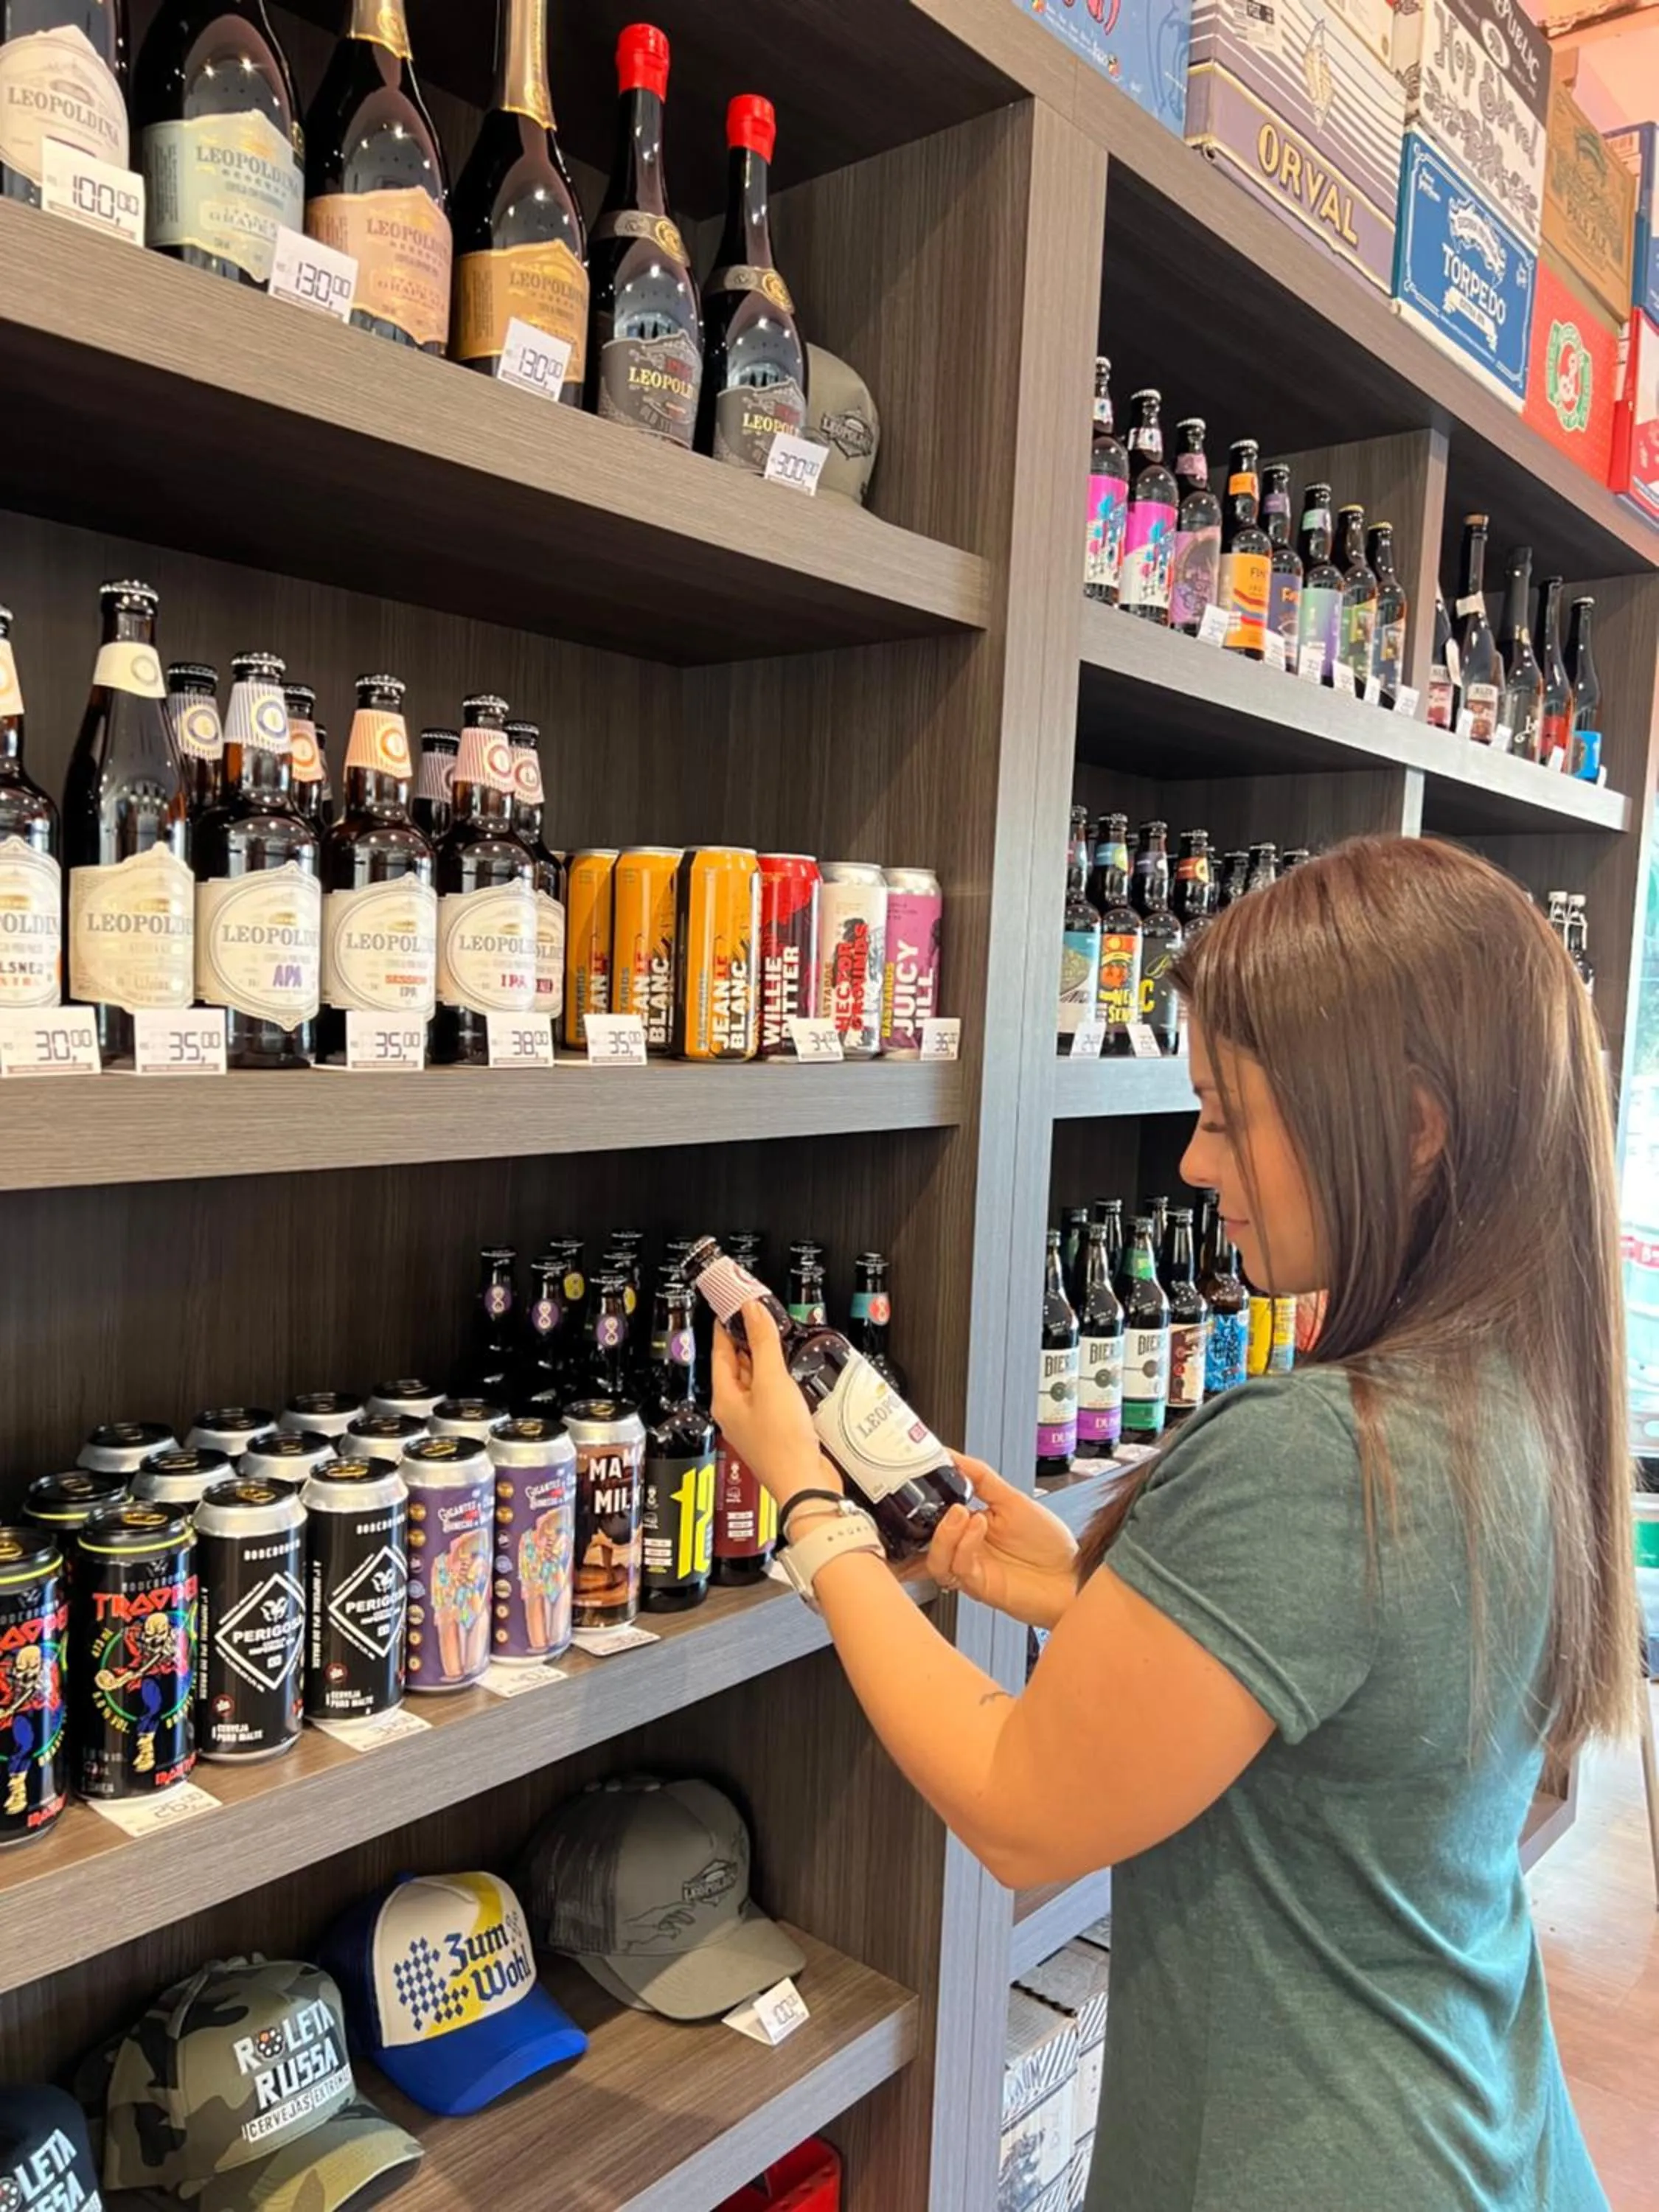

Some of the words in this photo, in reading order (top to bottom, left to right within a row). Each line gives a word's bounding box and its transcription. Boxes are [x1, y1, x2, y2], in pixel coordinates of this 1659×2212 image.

[8, 86, 120, 147] LEOPOLDINA
[1259, 122, 1359, 249] ORVAL
[1441, 243, 1506, 326] TORPEDO
[273, 964, 303, 987] APA
[501, 973, 526, 988] IPA
[590, 974, 608, 1015] AN
[649, 958, 669, 1043] BLANC
[730, 961, 747, 1050] BLANC
[763, 956, 782, 1047] WILLIE
[835, 943, 852, 1032] HECTOR
[881, 961, 894, 1037] BASTARDS
[893, 939, 919, 1038] JUICY
[713, 979, 731, 1050] JEAN
[594, 1484, 641, 1514] MILK
[92, 1573, 199, 1622] TROOPE
[470, 1944, 532, 2001] Wohl
[254, 2037, 339, 2110] RUSSA
[248, 2094, 312, 2139] CERVEJAS
